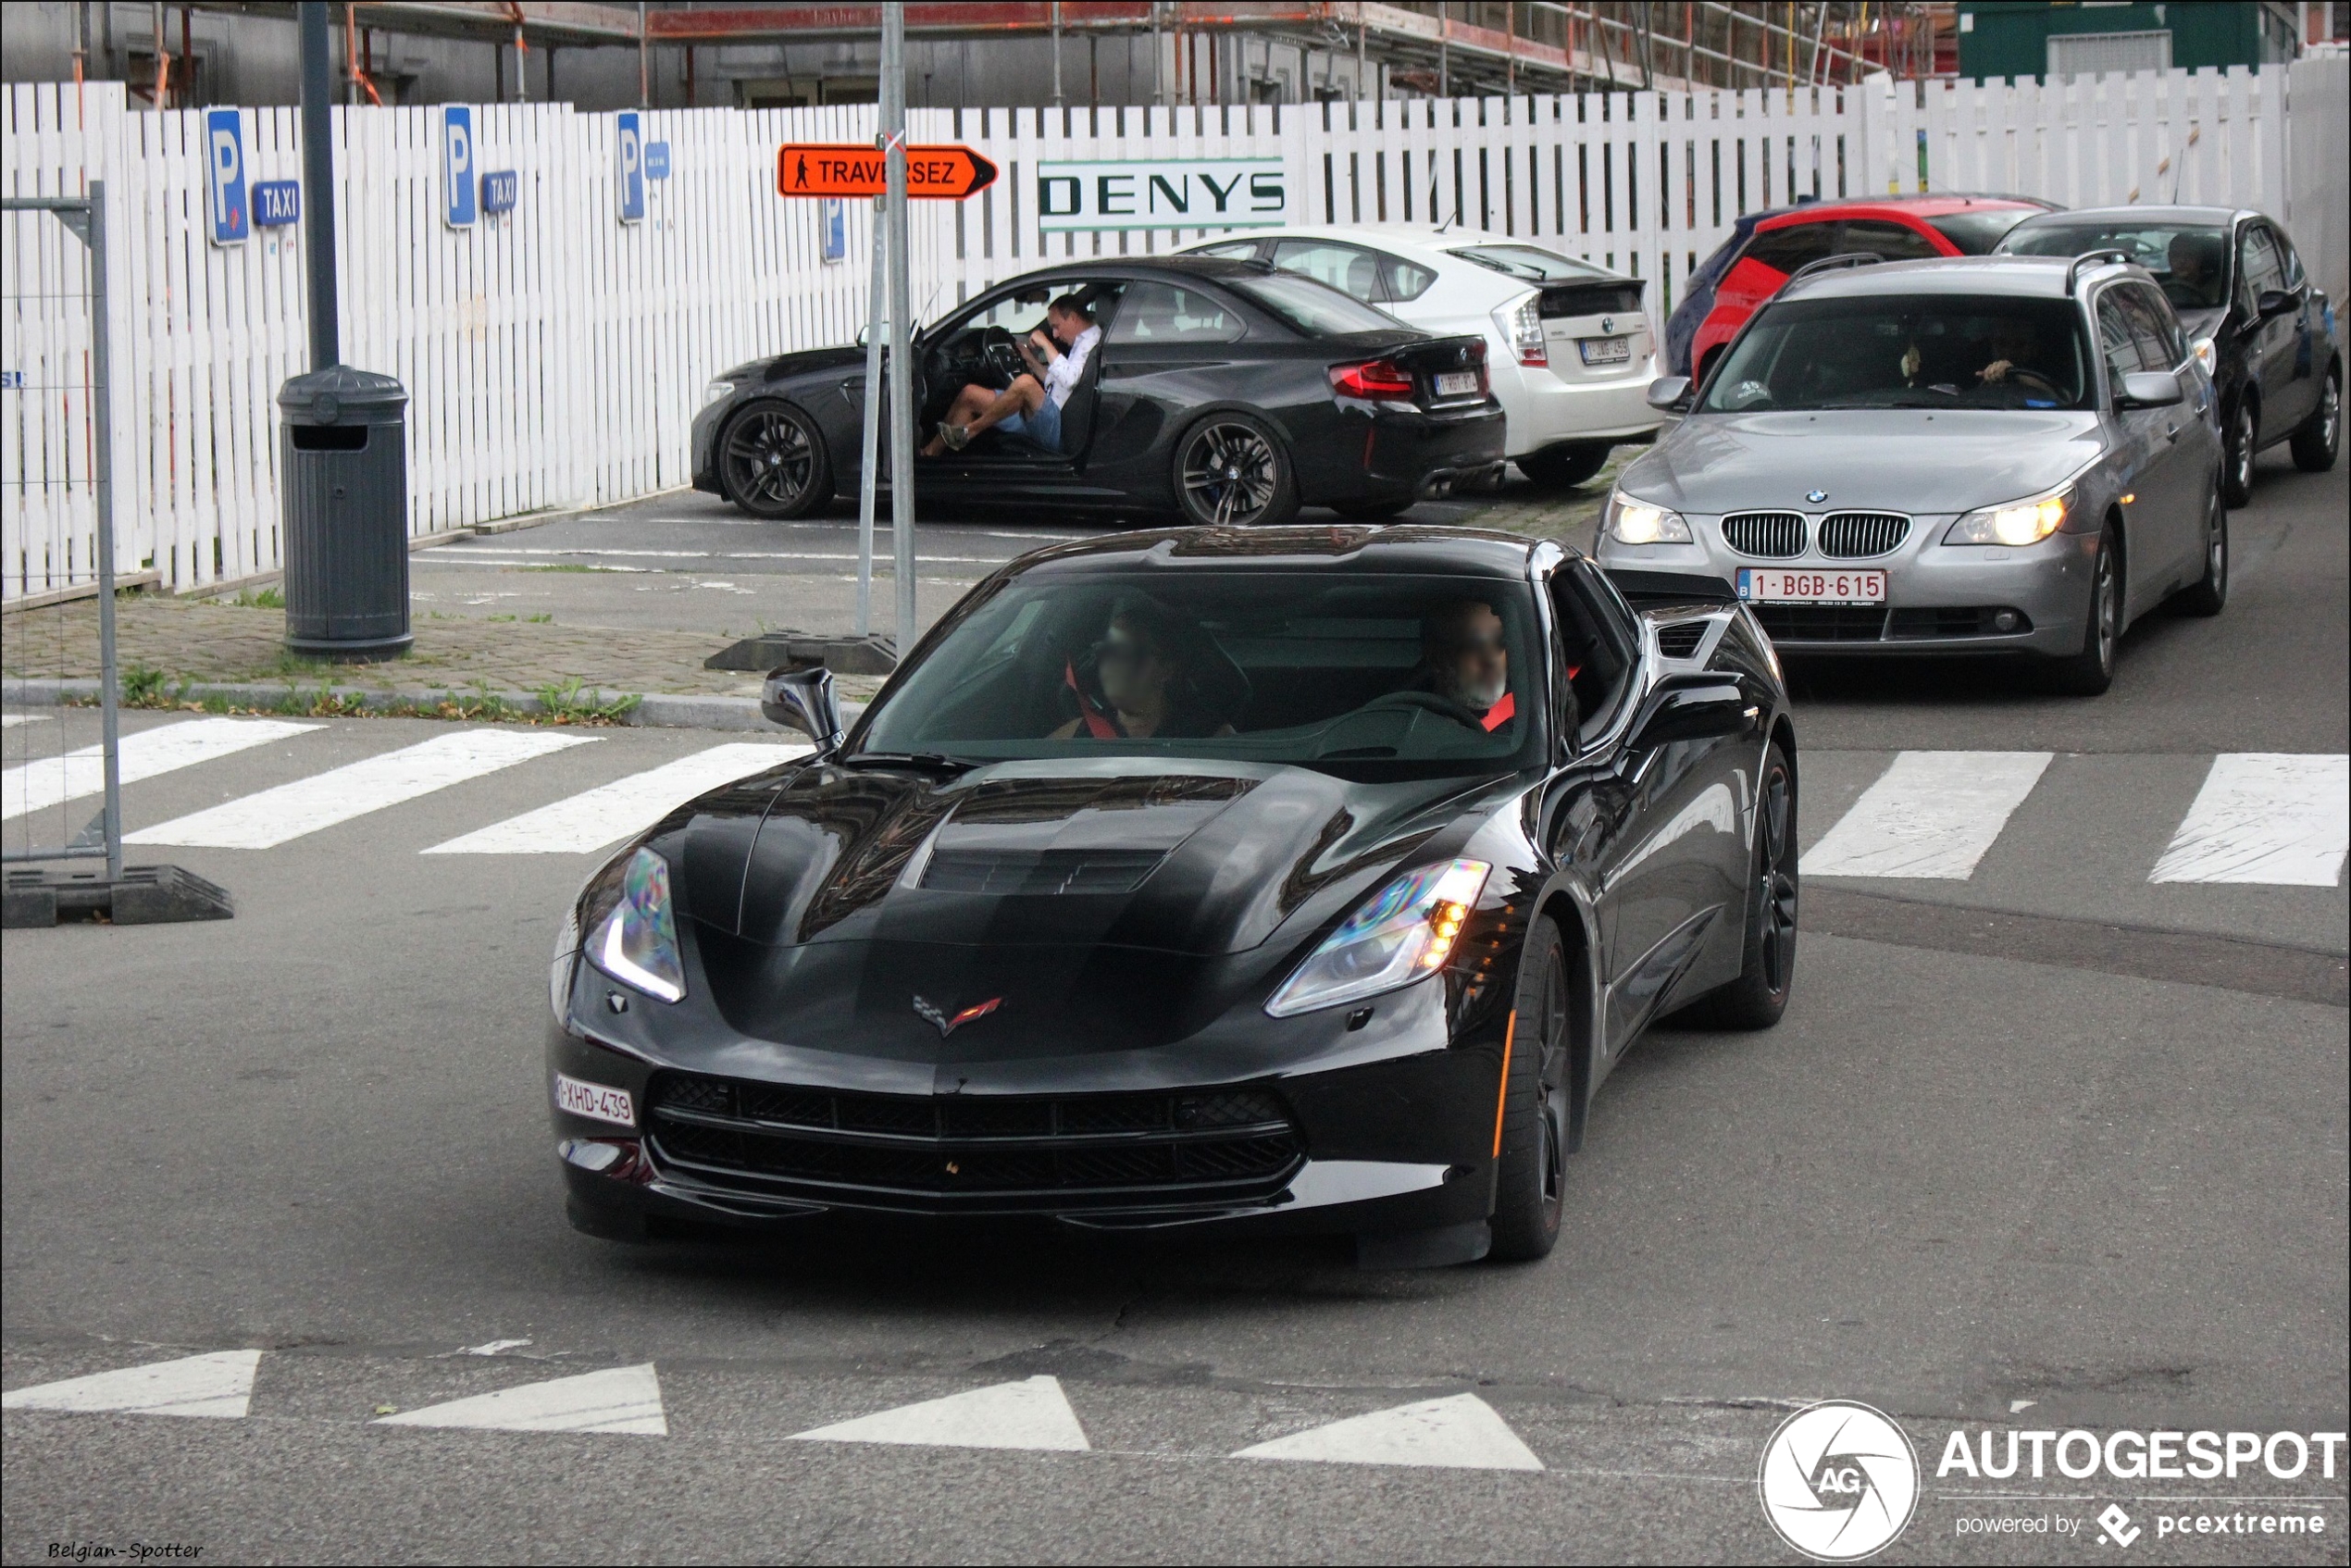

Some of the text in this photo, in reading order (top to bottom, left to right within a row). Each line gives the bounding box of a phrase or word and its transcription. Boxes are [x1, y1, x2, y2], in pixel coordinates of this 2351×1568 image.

[212, 130, 239, 224] P
[448, 124, 469, 208] P
[621, 128, 639, 205] P
[263, 188, 296, 218] TAXI
[491, 177, 515, 205] TAXI
[1039, 173, 1285, 216] DENYS
[1739, 575, 1880, 597] B 1-BGB-615
[558, 1079, 630, 1120] 1-XHD-439
